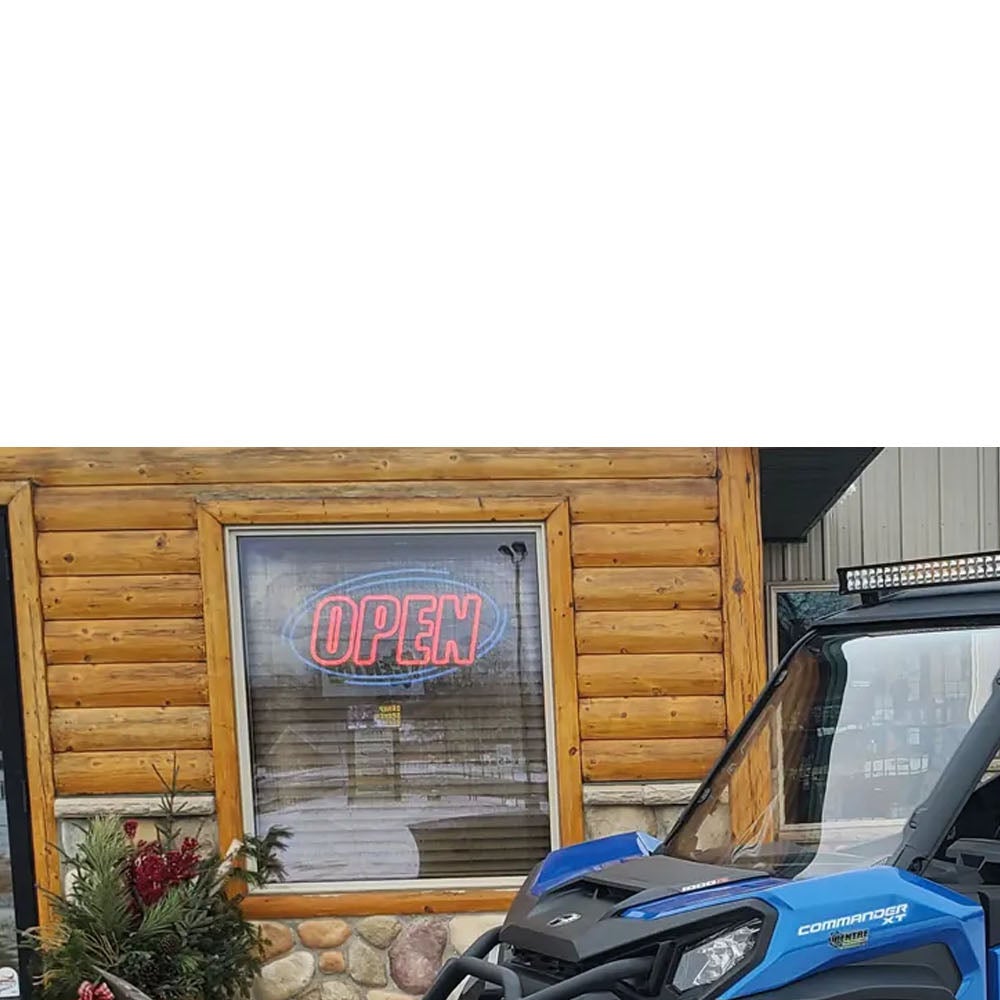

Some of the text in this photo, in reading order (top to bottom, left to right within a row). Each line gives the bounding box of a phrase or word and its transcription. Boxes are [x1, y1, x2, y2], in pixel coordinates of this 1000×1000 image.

[310, 594, 482, 666] OPEN
[798, 903, 908, 936] COMMANDER
[881, 914, 906, 925] XT
